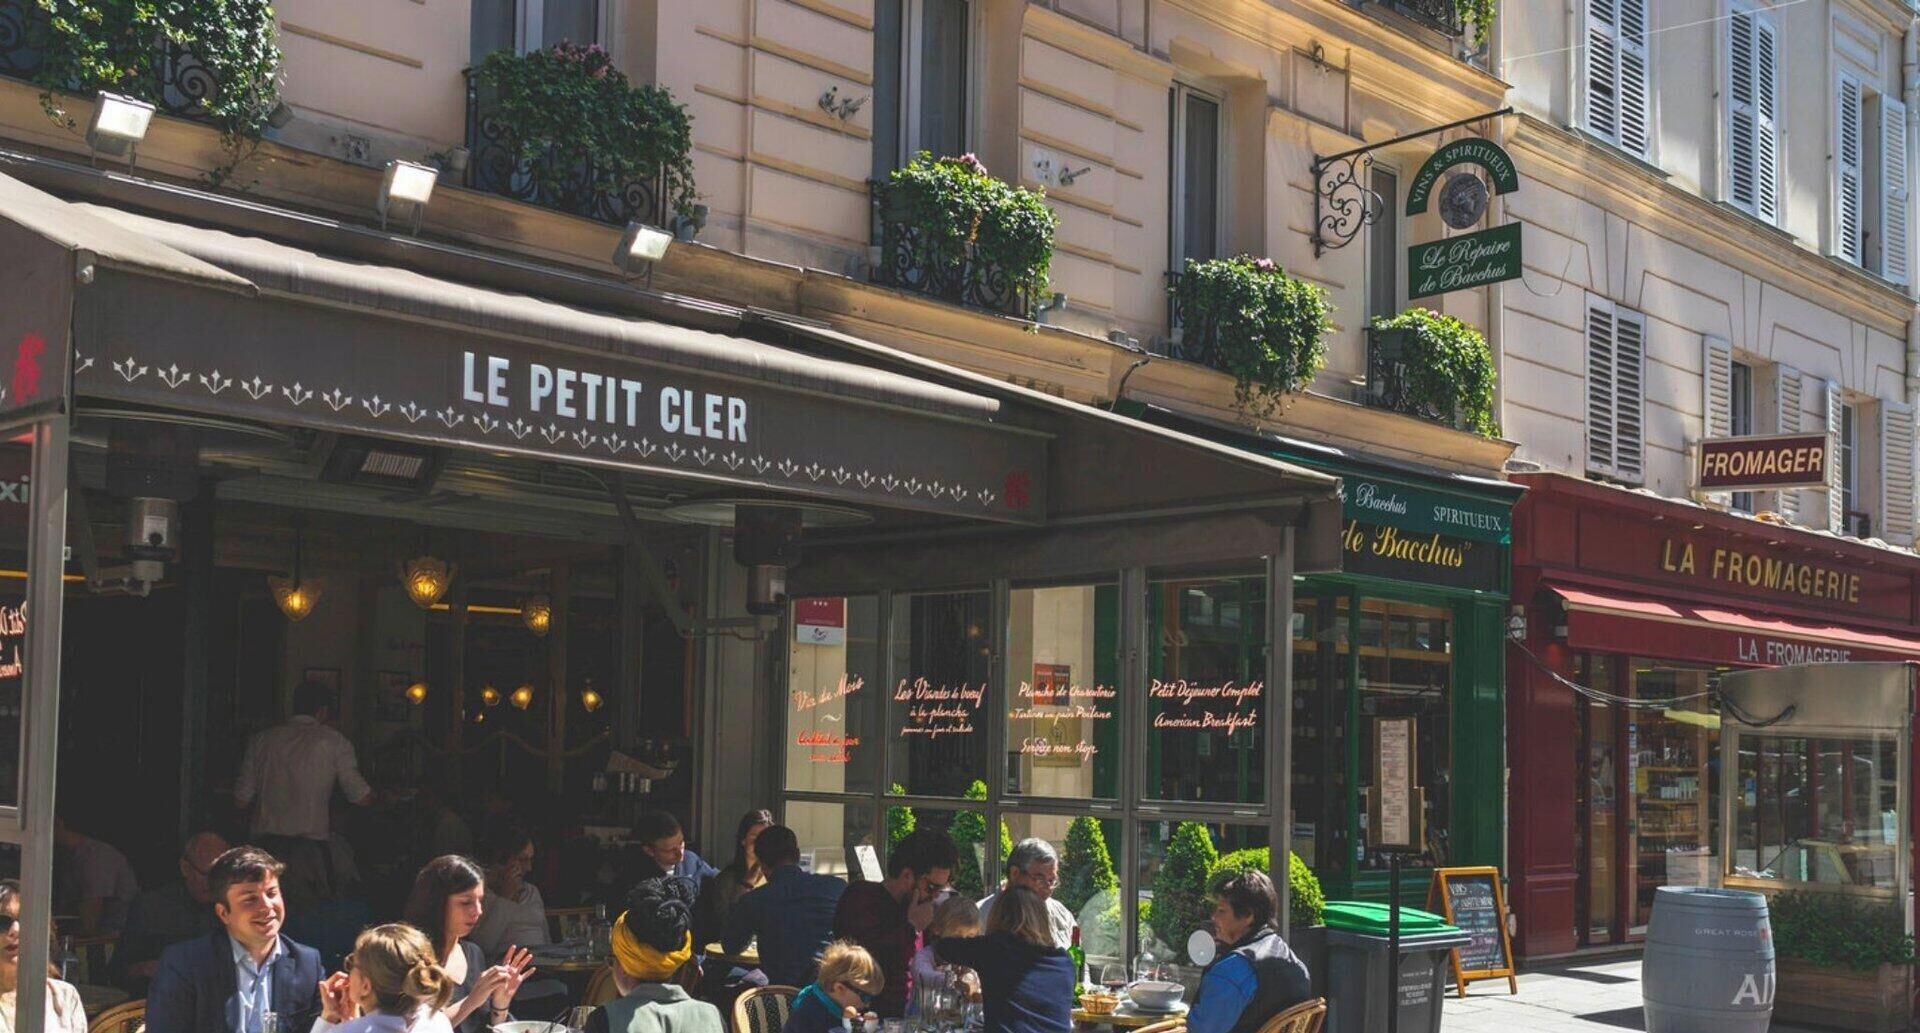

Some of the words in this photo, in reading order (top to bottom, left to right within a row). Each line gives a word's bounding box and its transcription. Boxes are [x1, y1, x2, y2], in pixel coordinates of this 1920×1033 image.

[1413, 171, 1434, 203] VINS
[1434, 159, 1444, 171] &
[1445, 144, 1510, 182] SPIRITUEUX
[1419, 246, 1446, 270] Le
[1448, 238, 1511, 266] Repaire
[1418, 274, 1436, 294] de
[1440, 262, 1507, 289] Bacchus
[463, 352, 510, 407] LE
[530, 363, 642, 427] PETIT
[660, 386, 748, 443] CLER
[1703, 447, 1823, 477] FROMAGER
[1355, 482, 1407, 515] Bacchus
[1433, 506, 1501, 531] SPIRITUEUX
[1341, 519, 1364, 552] de
[1664, 539, 1695, 575] LA
[1713, 549, 1860, 603] FROMAGERIE
[1738, 637, 1759, 662] LA
[1766, 641, 1852, 666] FROMAGERIE
[1149, 678, 1177, 698] Petit
[1221, 680, 1264, 706] Complet
[1154, 712, 1201, 728] American
[1202, 708, 1257, 736] Breakfast
[1695, 928, 1731, 936] GREAT
